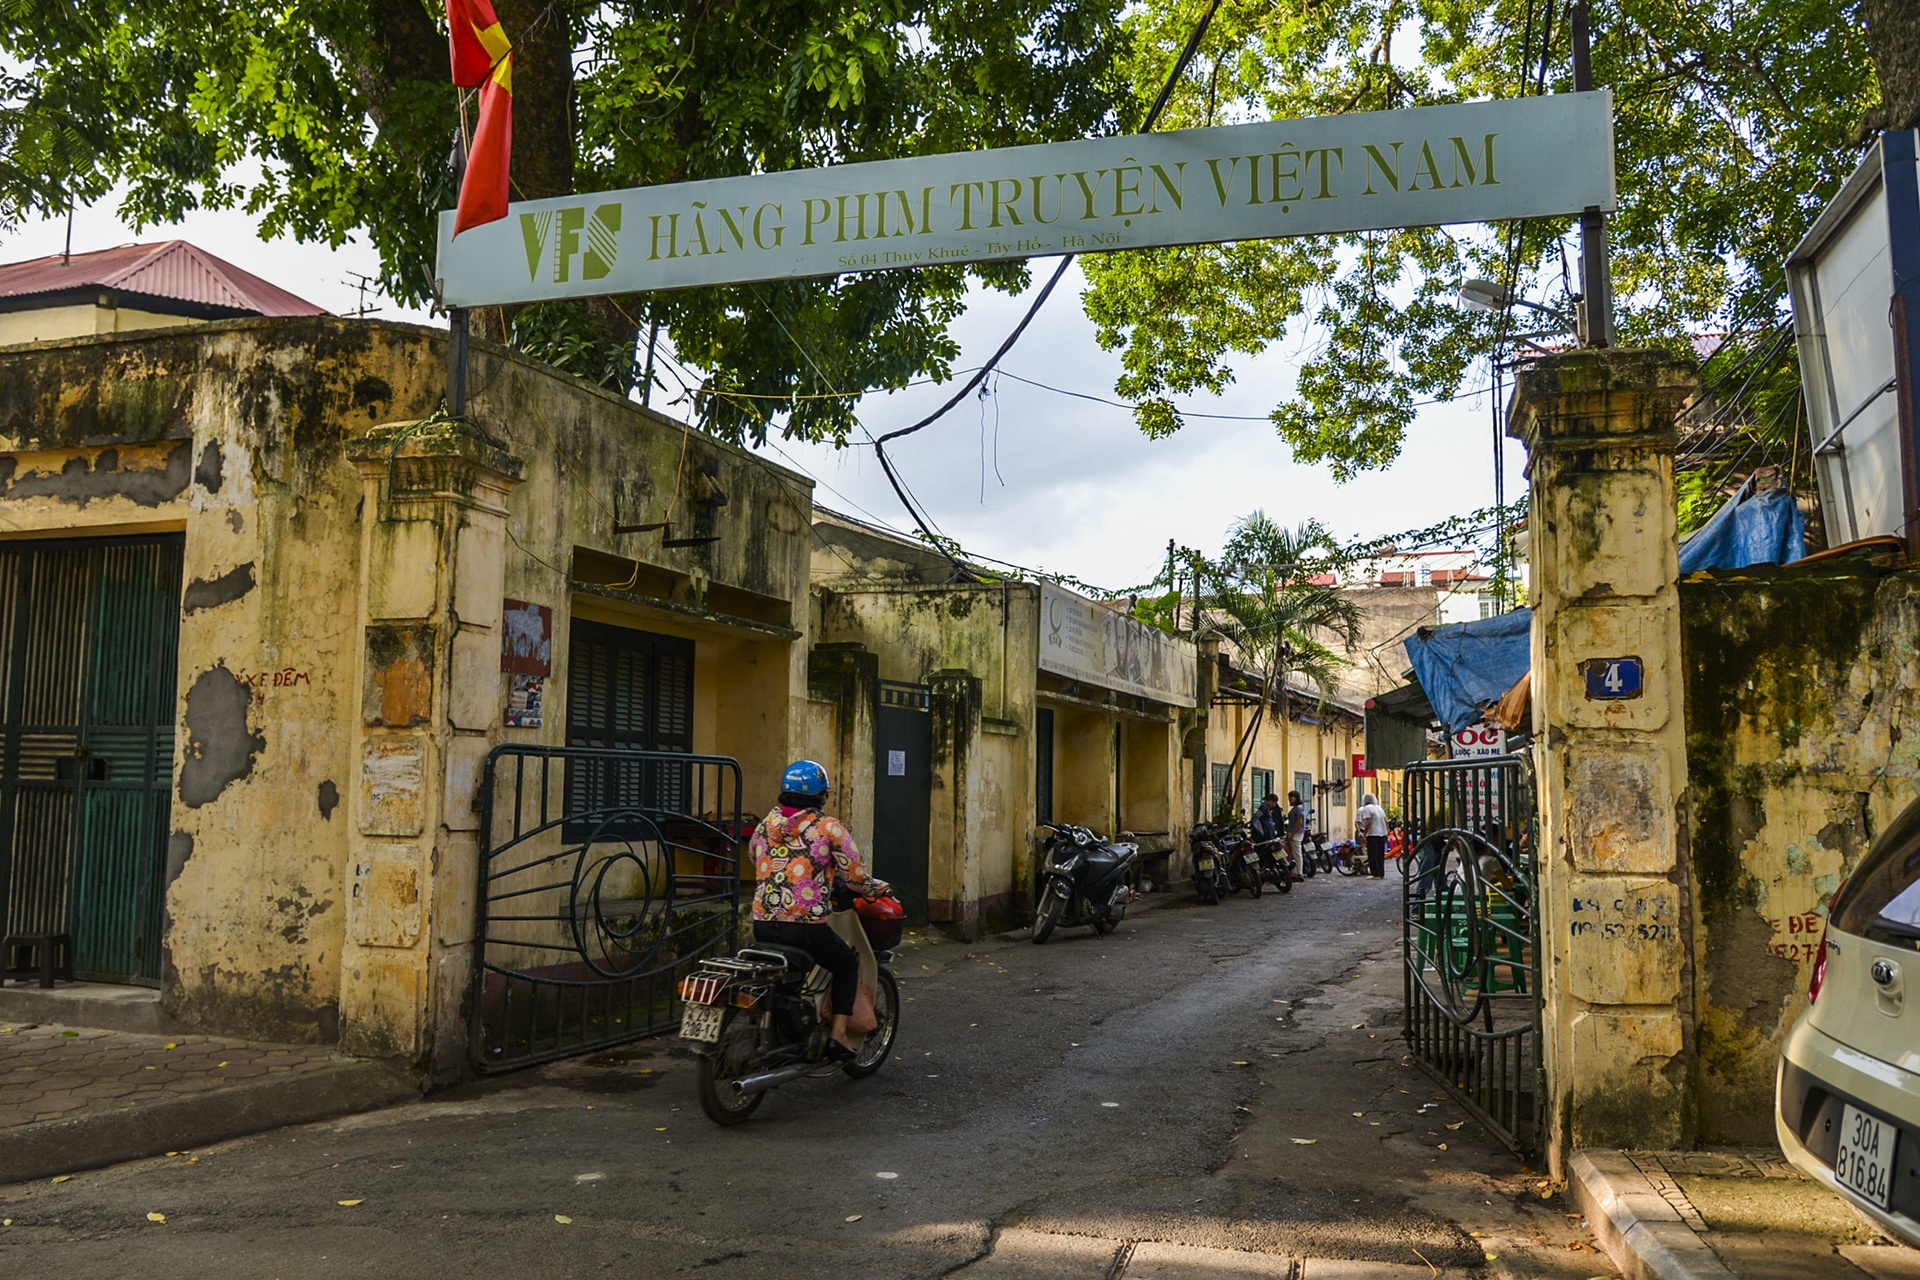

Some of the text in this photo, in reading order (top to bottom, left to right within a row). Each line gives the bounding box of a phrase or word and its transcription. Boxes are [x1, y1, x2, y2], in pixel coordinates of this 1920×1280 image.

[519, 133, 1502, 284] VFS HÃNG PHIM TRUYỆN VIỆT NAM
[861, 254, 878, 265] 04
[928, 244, 969, 259] Khuê
[985, 242, 1011, 255] Tây
[1062, 235, 1085, 248] Hà
[1091, 231, 1120, 247] Nội
[273, 667, 310, 687] ĐÊM
[1605, 664, 1623, 692] 4
[696, 1007, 710, 1022] 29
[1852, 1113, 1879, 1158] 30A
[1838, 1145, 1885, 1203] 816.84
